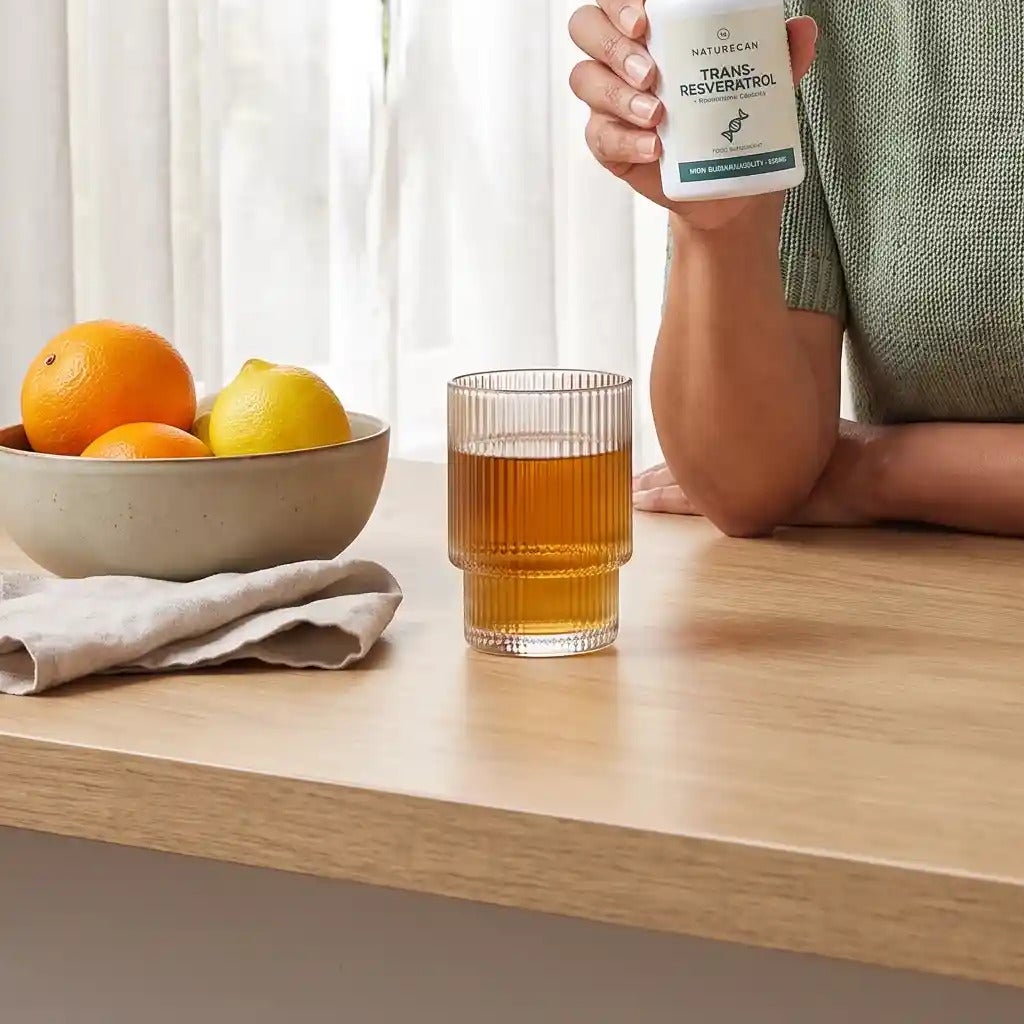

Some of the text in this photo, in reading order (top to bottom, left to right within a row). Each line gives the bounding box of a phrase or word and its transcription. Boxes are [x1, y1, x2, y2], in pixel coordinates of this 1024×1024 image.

[692, 41, 760, 57] NATURECAN
[700, 63, 755, 81] TRANS-
[680, 73, 777, 97] RESVERATROL
